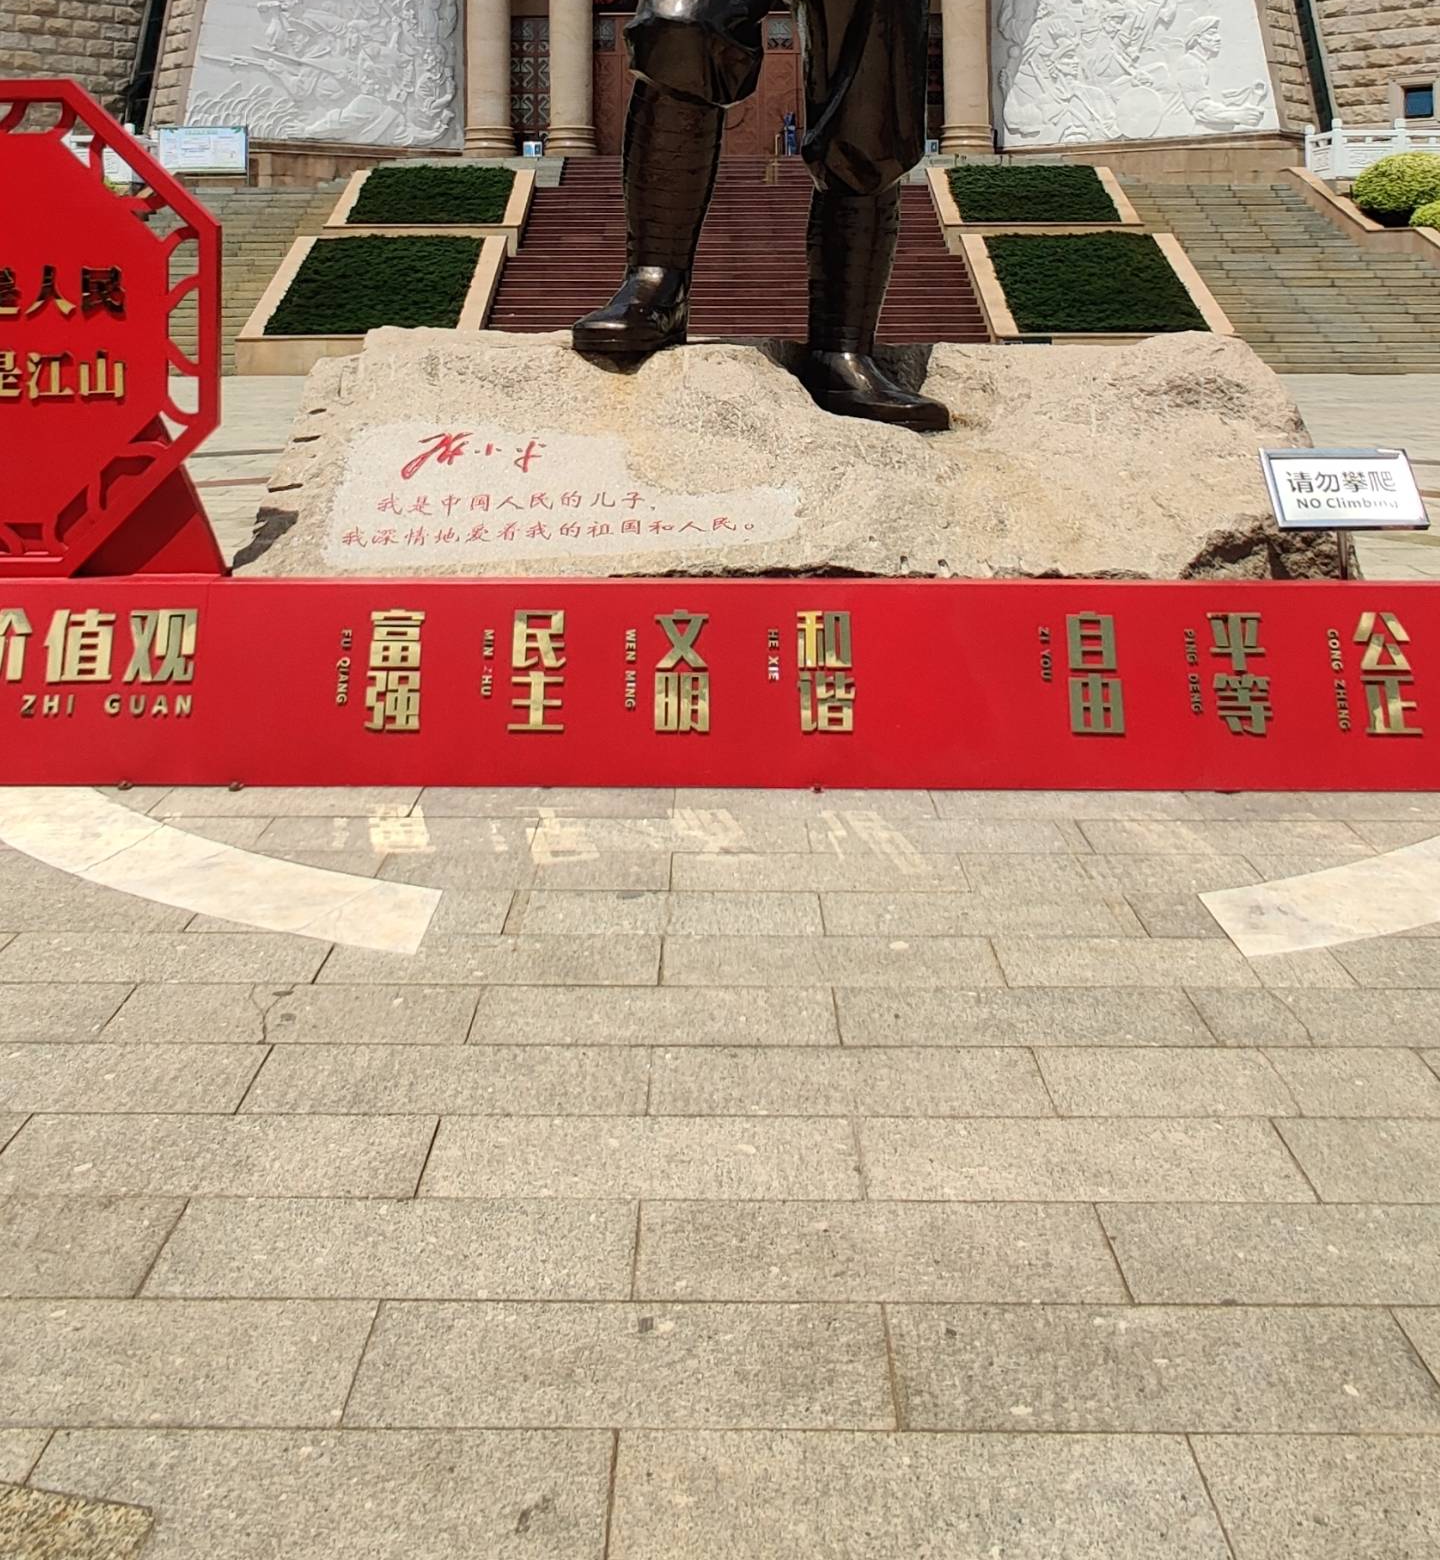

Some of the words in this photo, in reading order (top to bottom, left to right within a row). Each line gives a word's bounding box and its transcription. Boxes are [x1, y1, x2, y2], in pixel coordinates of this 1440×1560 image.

[1286, 471, 1397, 493] 请勿攀爬
[1297, 498, 1321, 509] NO
[340, 629, 352, 649] FU
[483, 629, 495, 657] MIN
[624, 629, 636, 661] WEN
[767, 629, 779, 649] HE
[1038, 626, 1050, 644] ZI
[1184, 628, 1198, 666] PING
[1327, 628, 1344, 672] GONG
[336, 656, 350, 704] QIANG
[364, 609, 425, 732] 富强
[480, 666, 494, 697] ZHU
[507, 610, 566, 732] 民主
[654, 609, 710, 732] 文明
[767, 655, 780, 681] XIE
[796, 611, 855, 732] 和谐
[1040, 649, 1052, 682] YOU
[1066, 611, 1126, 735] 自由
[1206, 612, 1273, 735] 平等
[1352, 611, 1424, 735] 公正
[20, 694, 75, 717] ZHI
[104, 693, 193, 717] GUAN
[624, 670, 636, 710] MING
[1189, 673, 1203, 714] DENG
[1335, 679, 1351, 732] ZHENG
